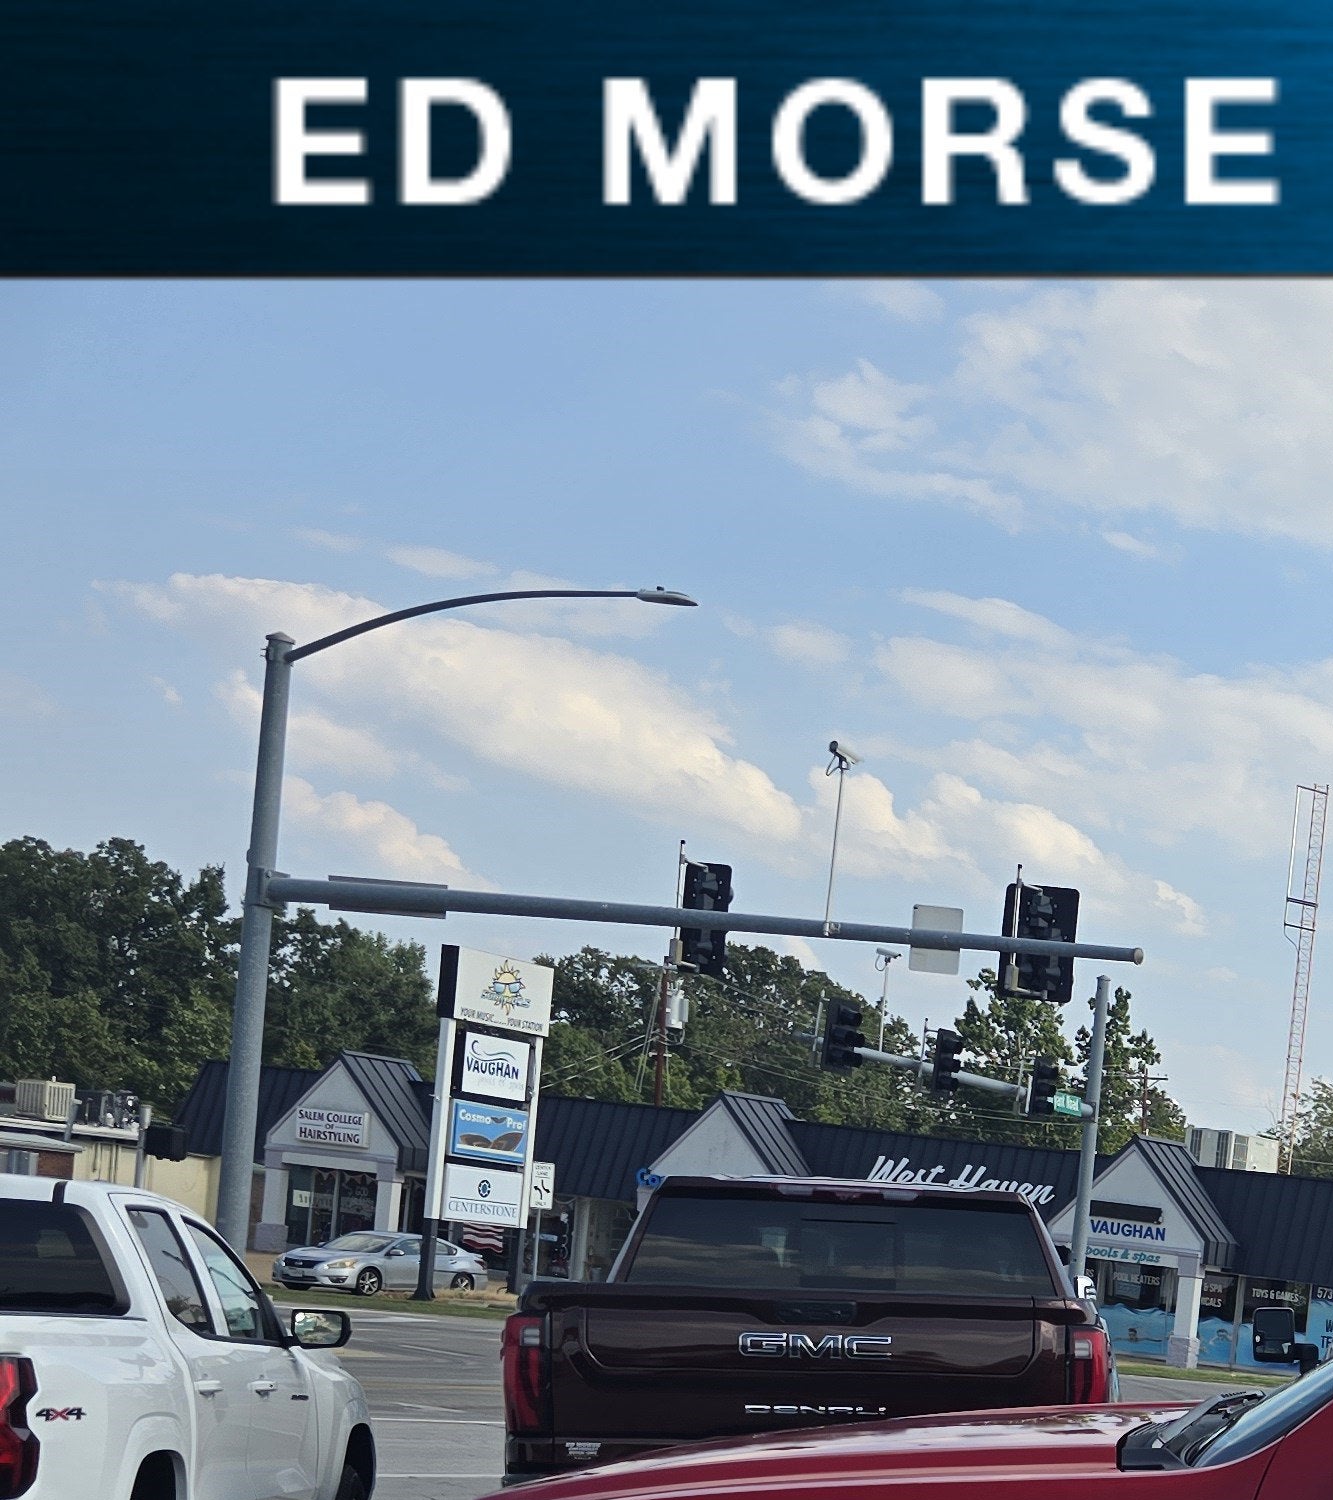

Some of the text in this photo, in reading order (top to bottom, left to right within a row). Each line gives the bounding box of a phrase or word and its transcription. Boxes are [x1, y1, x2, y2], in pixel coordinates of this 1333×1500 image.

[460, 1006, 476, 1018] YOUR
[521, 1020, 544, 1033] STATION
[466, 1056, 519, 1080] VAUGHAN
[298, 1109, 363, 1126] SALEM COLLEGE
[460, 1108, 491, 1125] Cosmo
[299, 1126, 361, 1144] HAIRSTYLING
[867, 1155, 1056, 1205] West Haven
[448, 1200, 519, 1219] CENTERSTONE
[1090, 1219, 1167, 1242] VAUGHAN
[1132, 1252, 1161, 1264] spas
[1133, 1274, 1160, 1286] HEATERS
[1252, 1287, 1269, 1299] TOYS
[1276, 1290, 1299, 1303] GAMES
[738, 1332, 893, 1361] GMC
